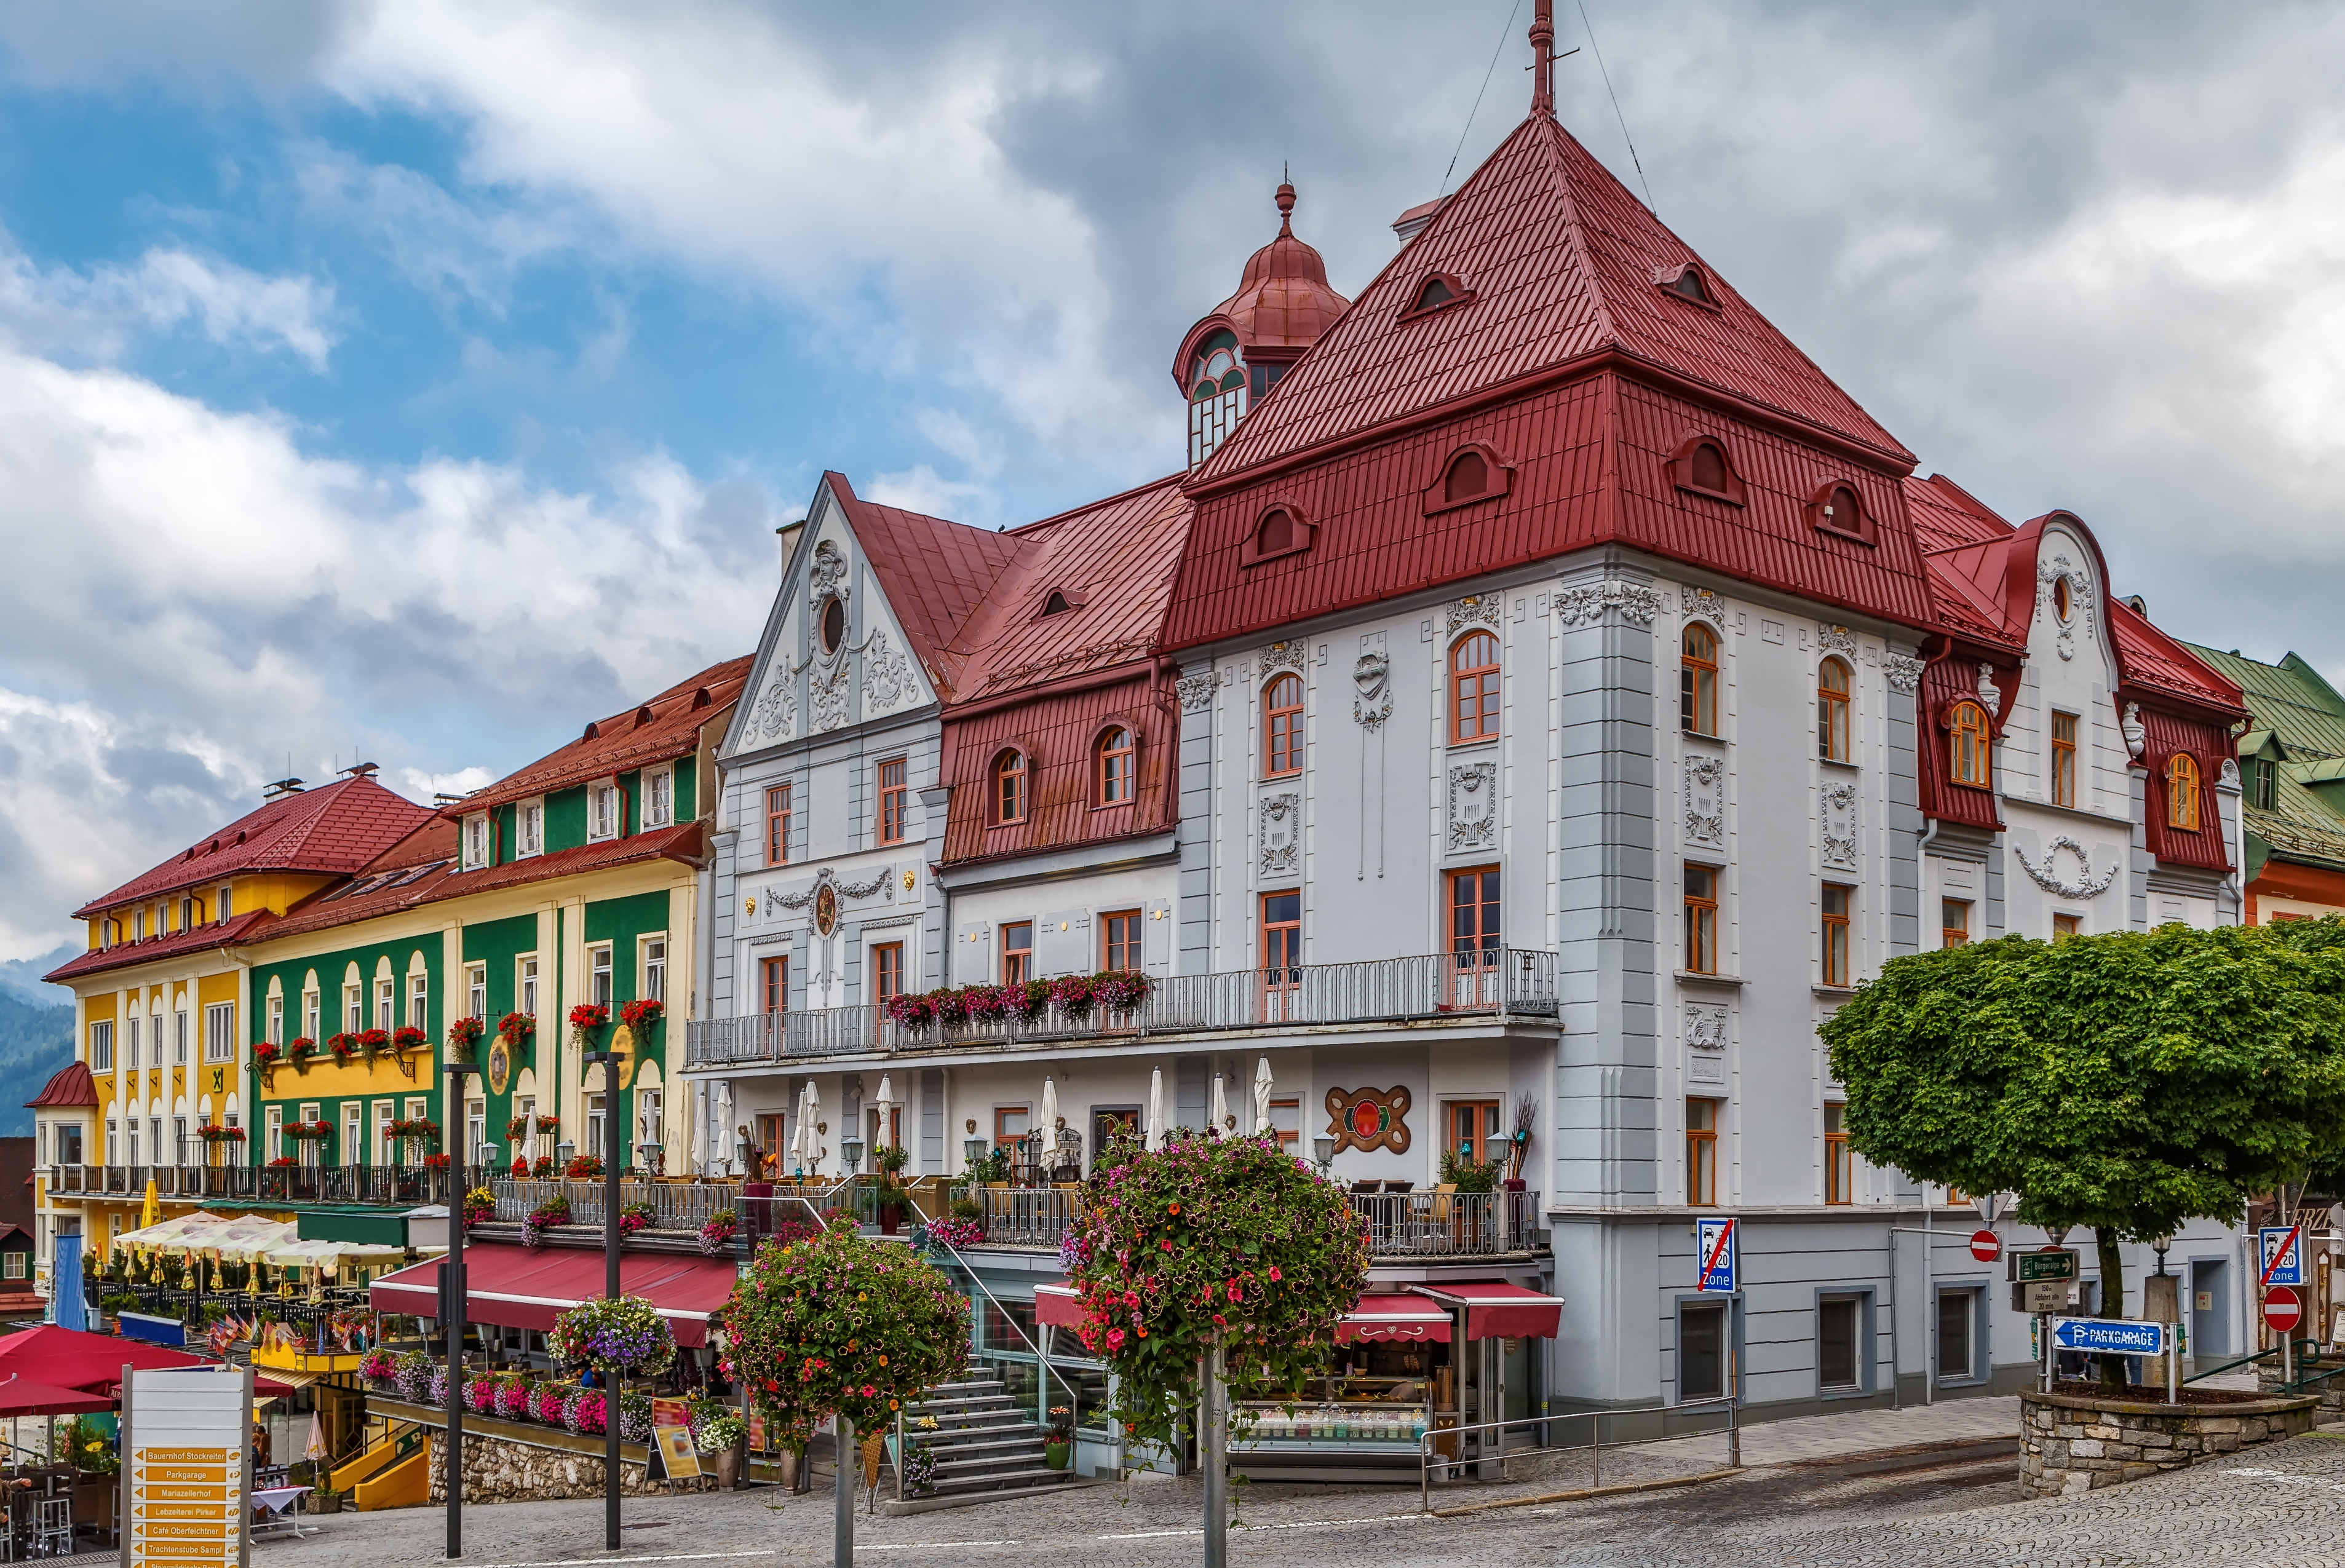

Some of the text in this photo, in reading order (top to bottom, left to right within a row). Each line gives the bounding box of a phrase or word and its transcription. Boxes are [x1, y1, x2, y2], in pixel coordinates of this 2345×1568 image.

[1718, 1254, 1728, 1265] 20
[2283, 1255, 2294, 1265] 20
[2035, 1262, 2060, 1271] Bürgeralpe
[1703, 1272, 1729, 1286] Zone
[2269, 1271, 2293, 1280] Zone
[2090, 1329, 2154, 1346] PARKGARAGE
[186, 1452, 225, 1460] Stockreiter
[166, 1471, 207, 1481] Parkgarage
[161, 1489, 212, 1497] Mariazellerhof
[153, 1526, 219, 1535] Café Oberfeichtner
[149, 1545, 223, 1556] Trachtenstube Sampl
